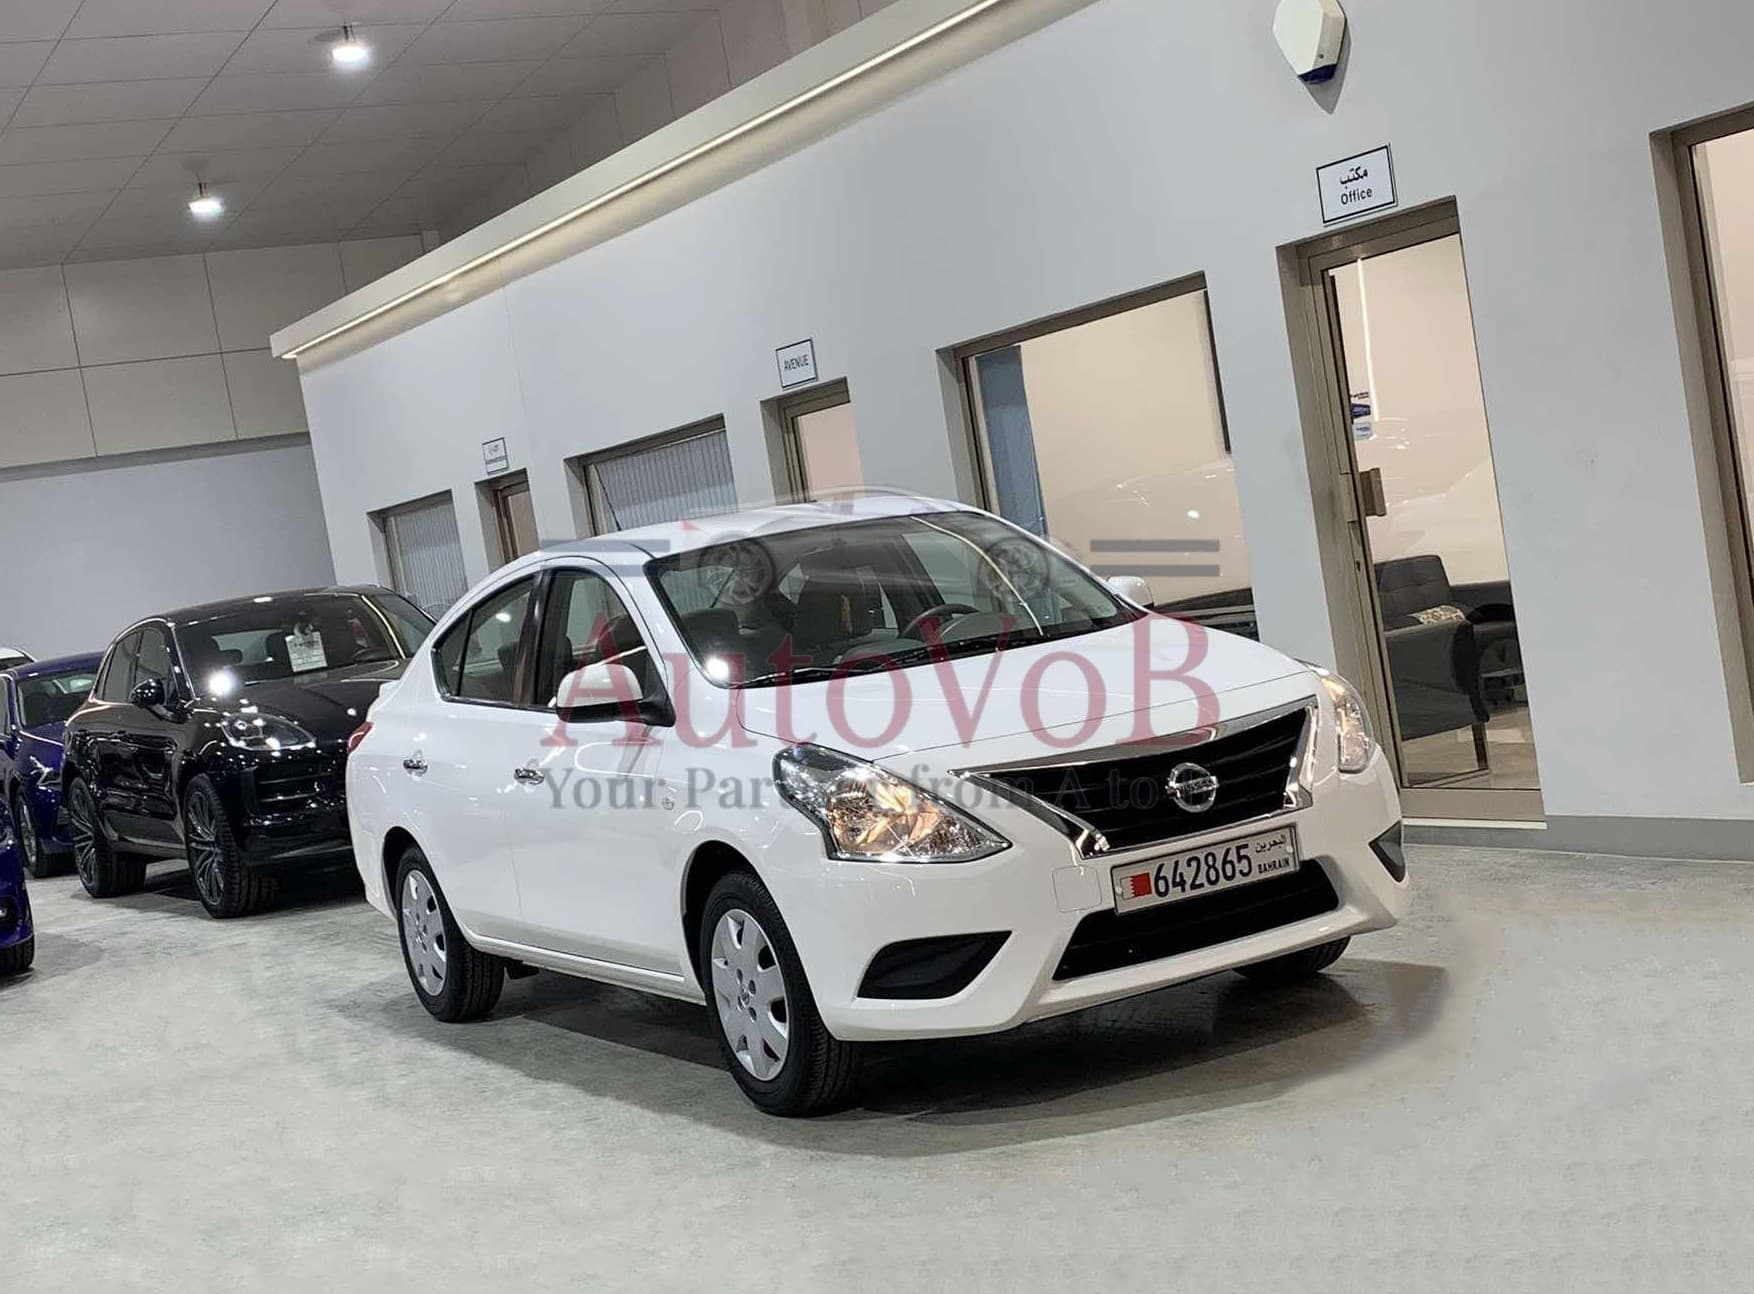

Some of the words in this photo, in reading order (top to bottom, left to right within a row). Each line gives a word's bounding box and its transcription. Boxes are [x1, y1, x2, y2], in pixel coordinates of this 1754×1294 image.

[1340, 166, 1368, 189] مكتب
[1341, 188, 1372, 205] Office
[1255, 833, 1287, 854] البحرين
[1154, 843, 1252, 898] 642865
[1257, 857, 1290, 875] BAHRAIN
